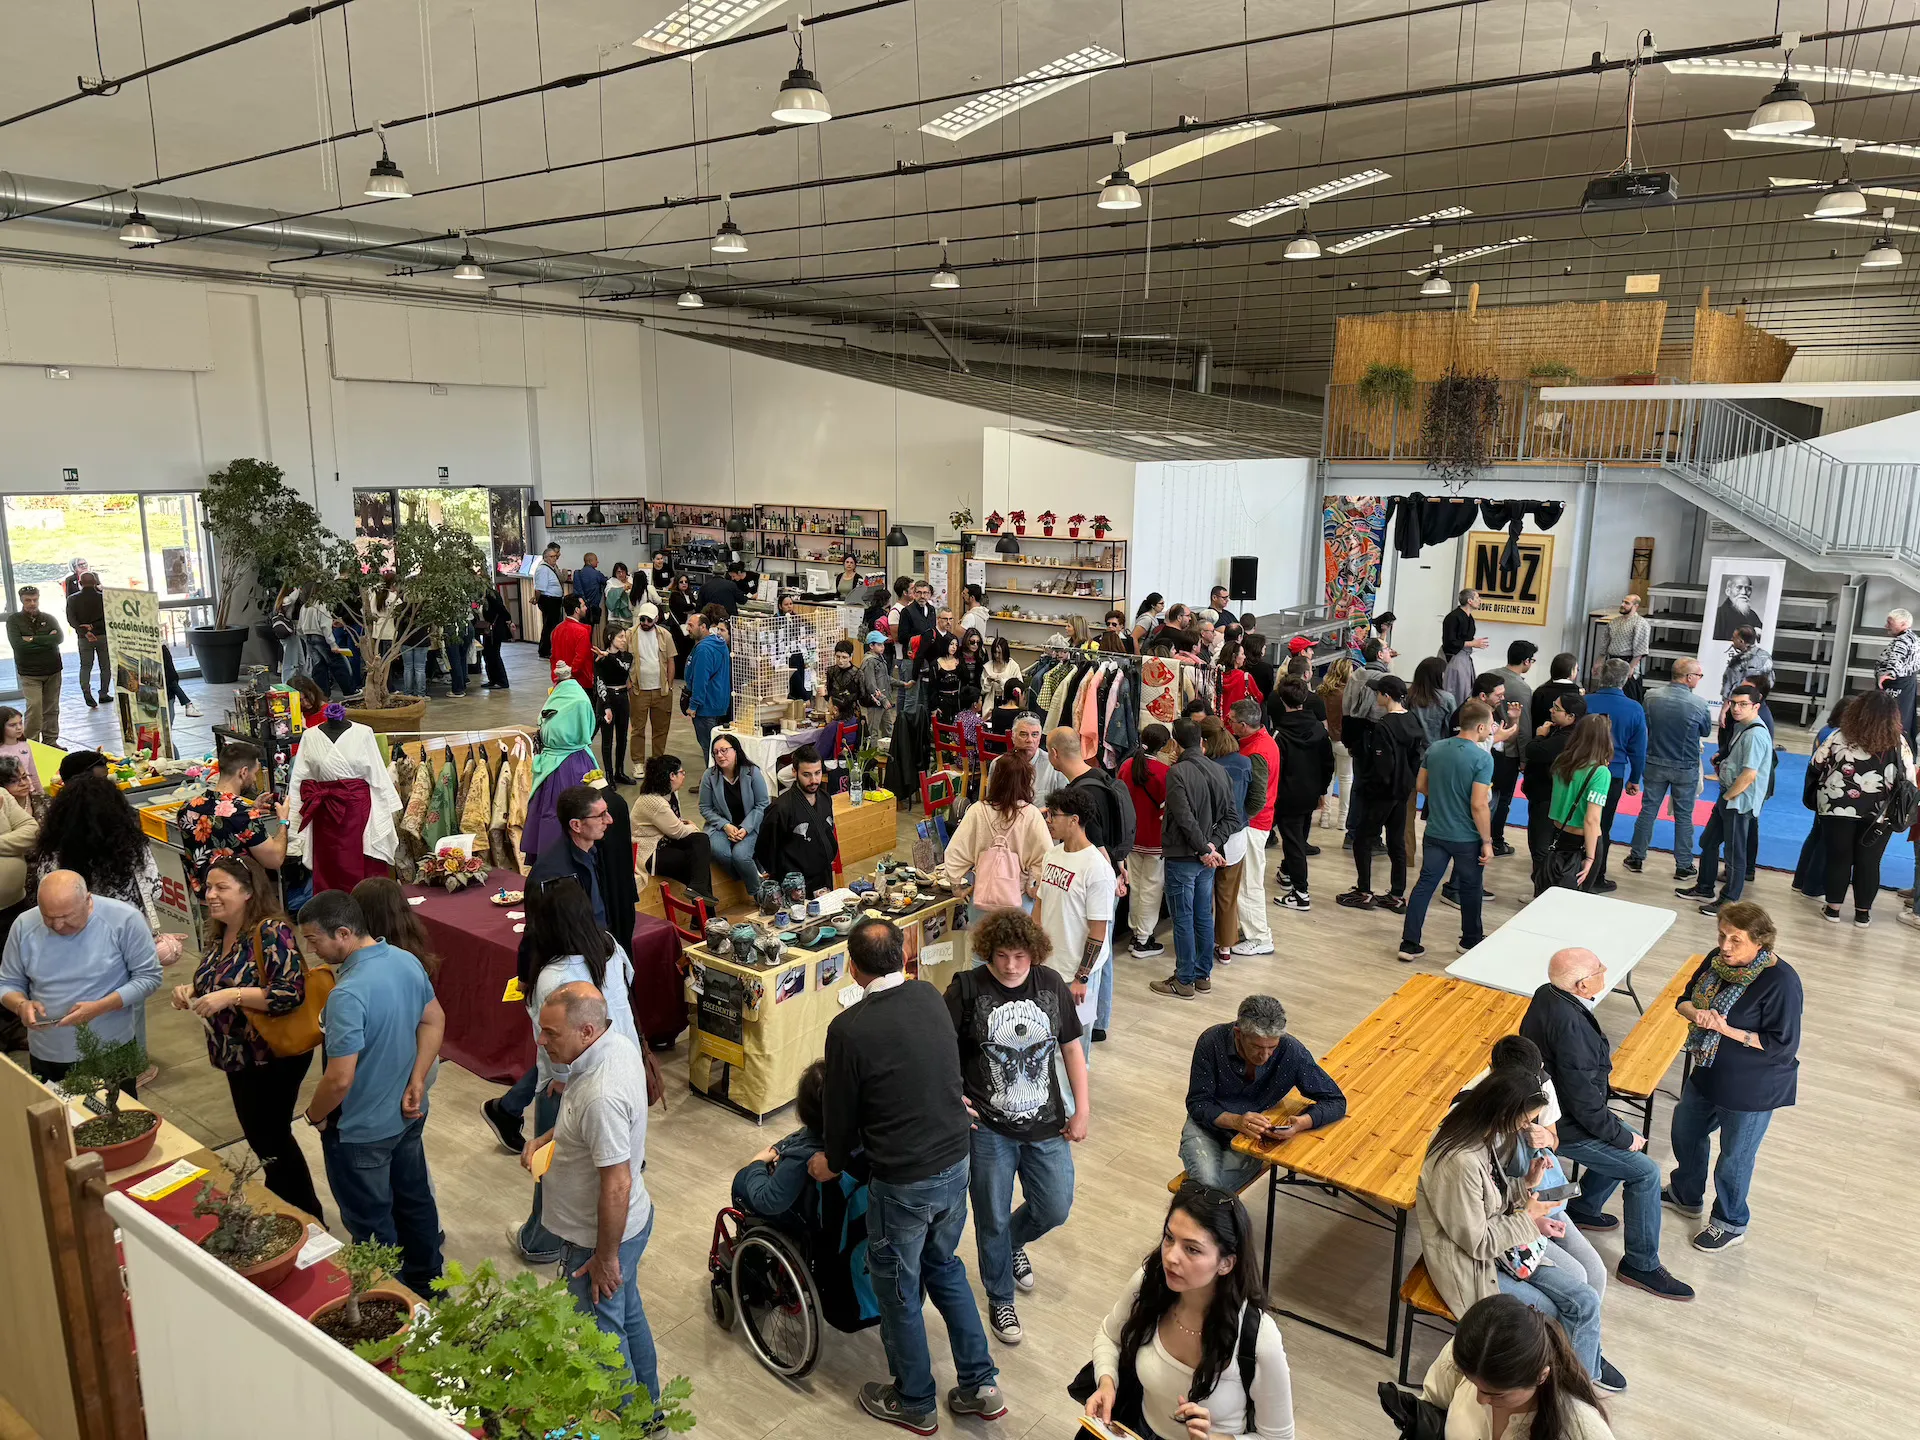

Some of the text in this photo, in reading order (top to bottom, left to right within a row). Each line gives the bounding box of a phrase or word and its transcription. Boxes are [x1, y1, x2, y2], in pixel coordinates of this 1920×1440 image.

[1494, 603, 1520, 615] OFFICINE
[1522, 606, 1535, 615] ZISA
[1042, 864, 1074, 891] MARVEL
